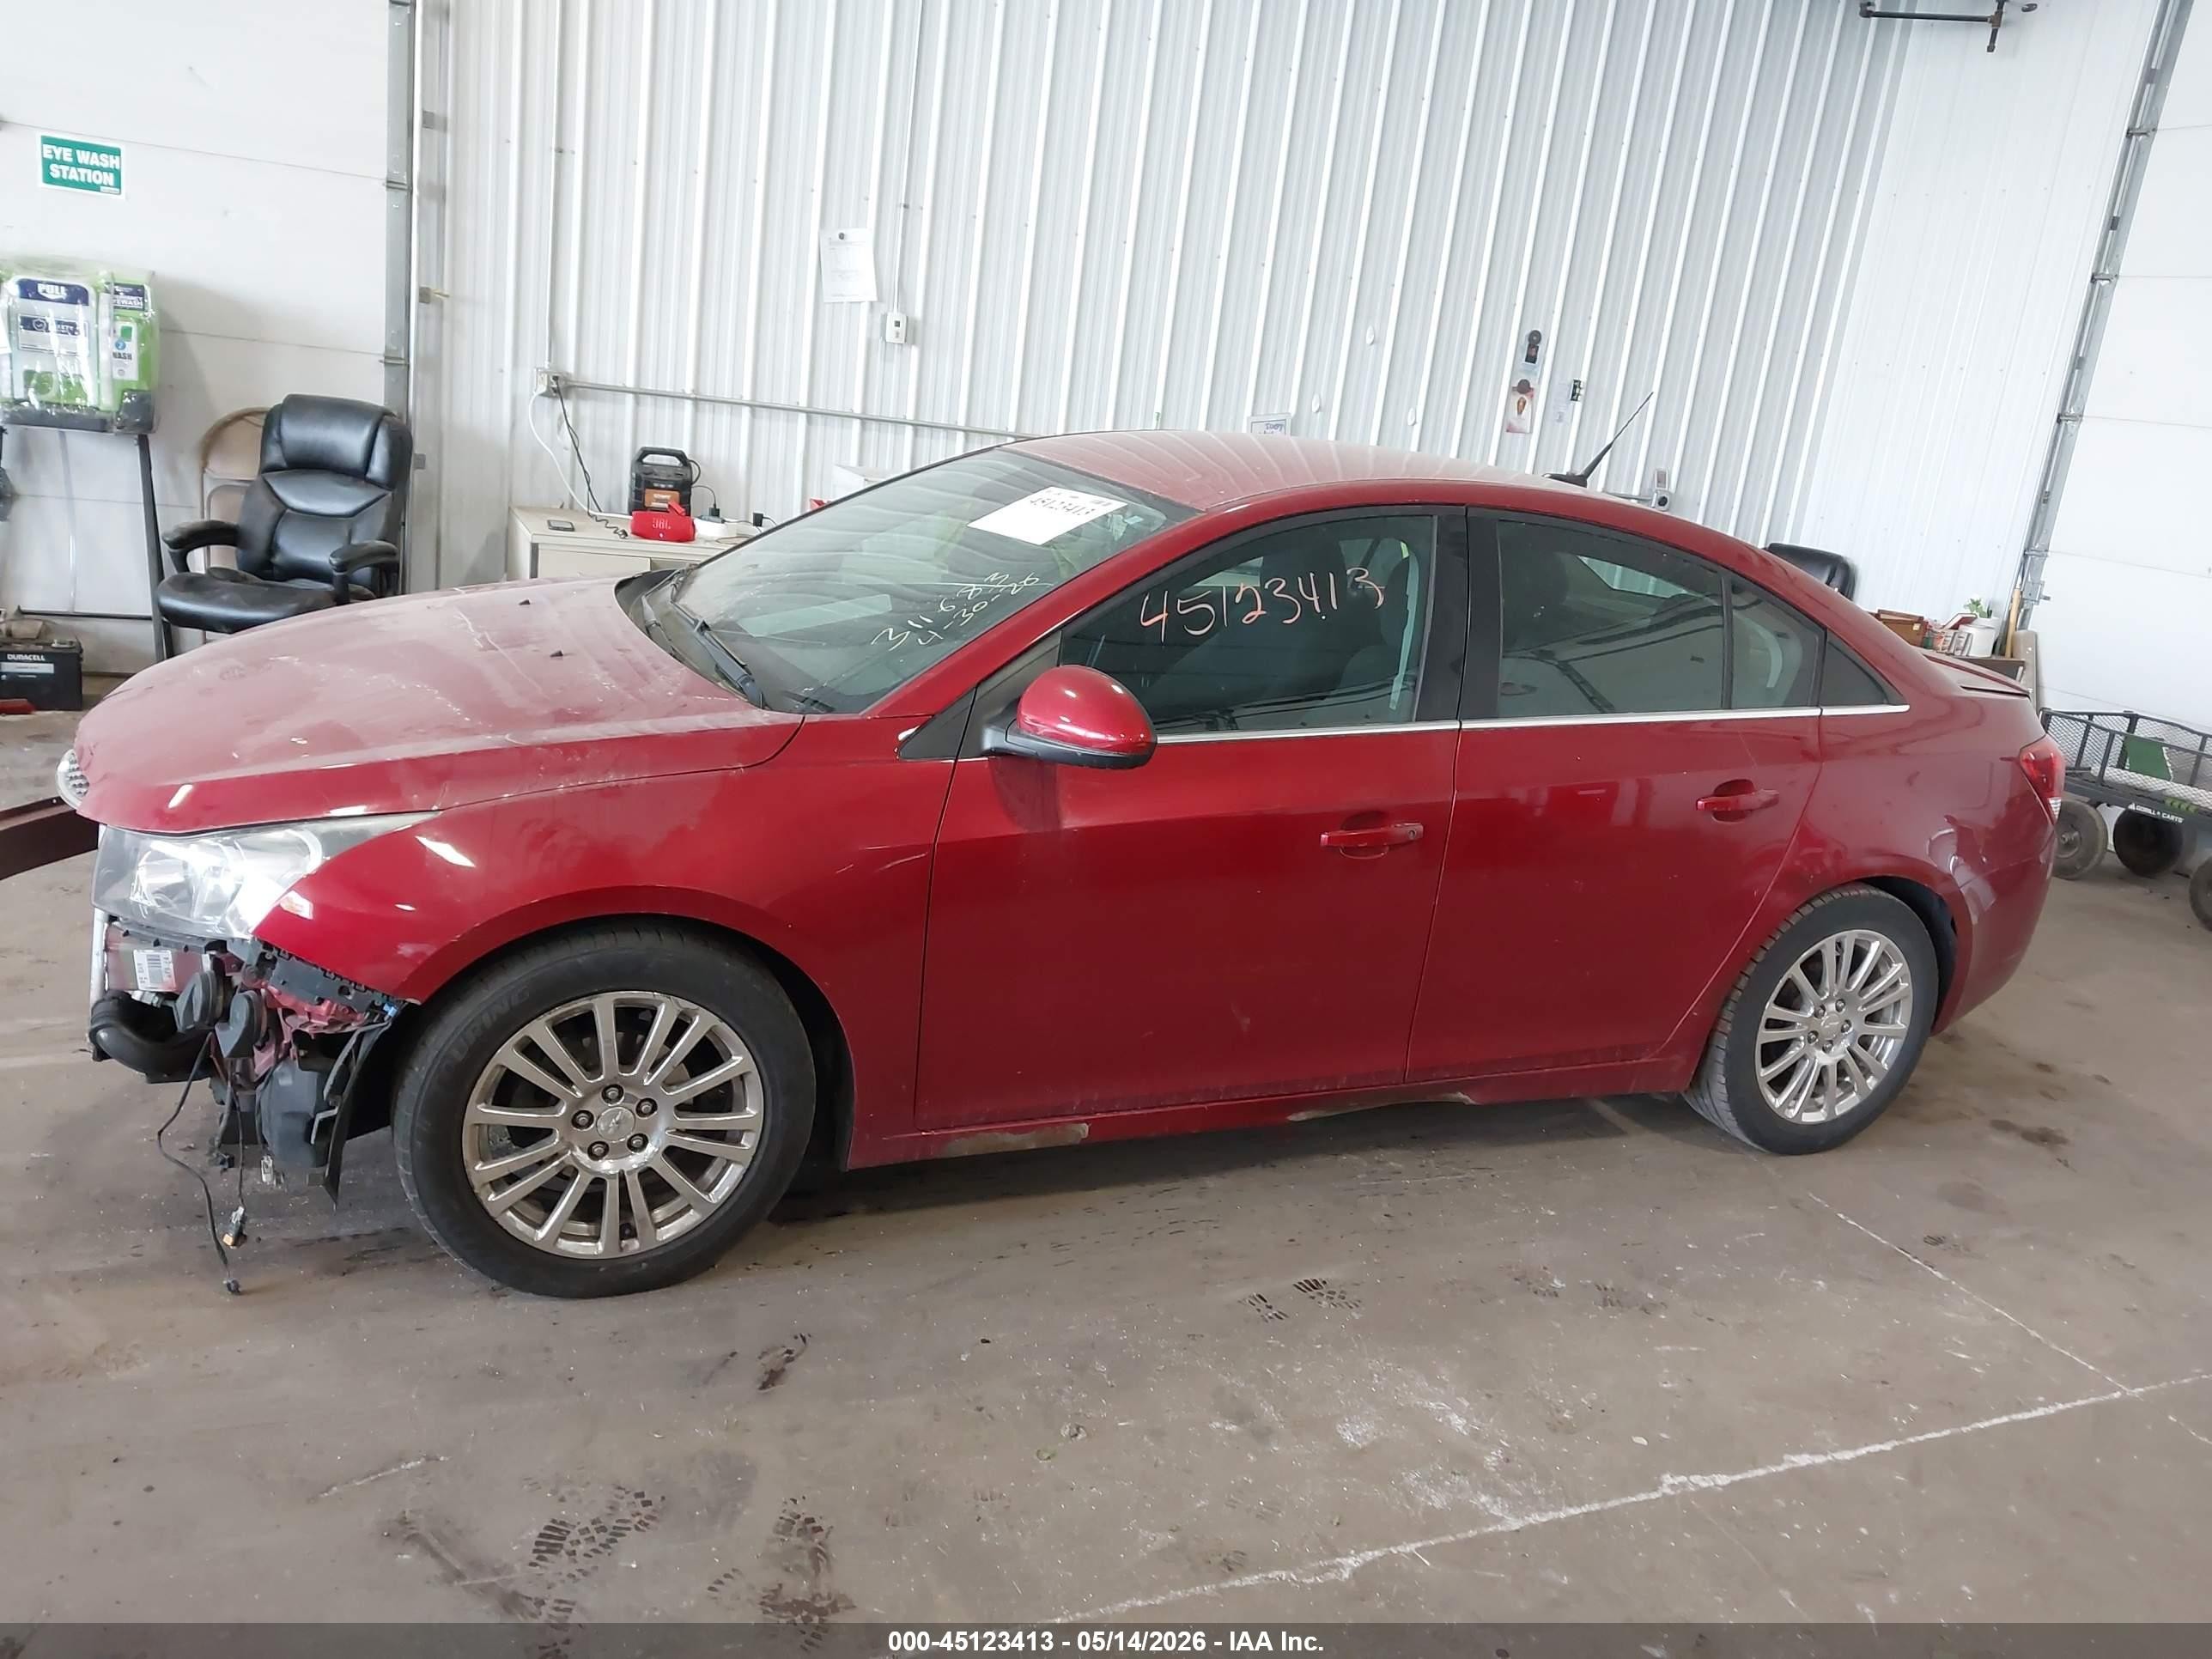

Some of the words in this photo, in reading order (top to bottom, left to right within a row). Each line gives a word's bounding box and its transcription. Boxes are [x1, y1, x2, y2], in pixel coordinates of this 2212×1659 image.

[43, 144, 73, 162] EYE
[76, 149, 120, 170] WASH
[49, 163, 114, 186] STATION
[653, 517, 671, 530] JBL
[1139, 567, 1385, 643] 45123413
